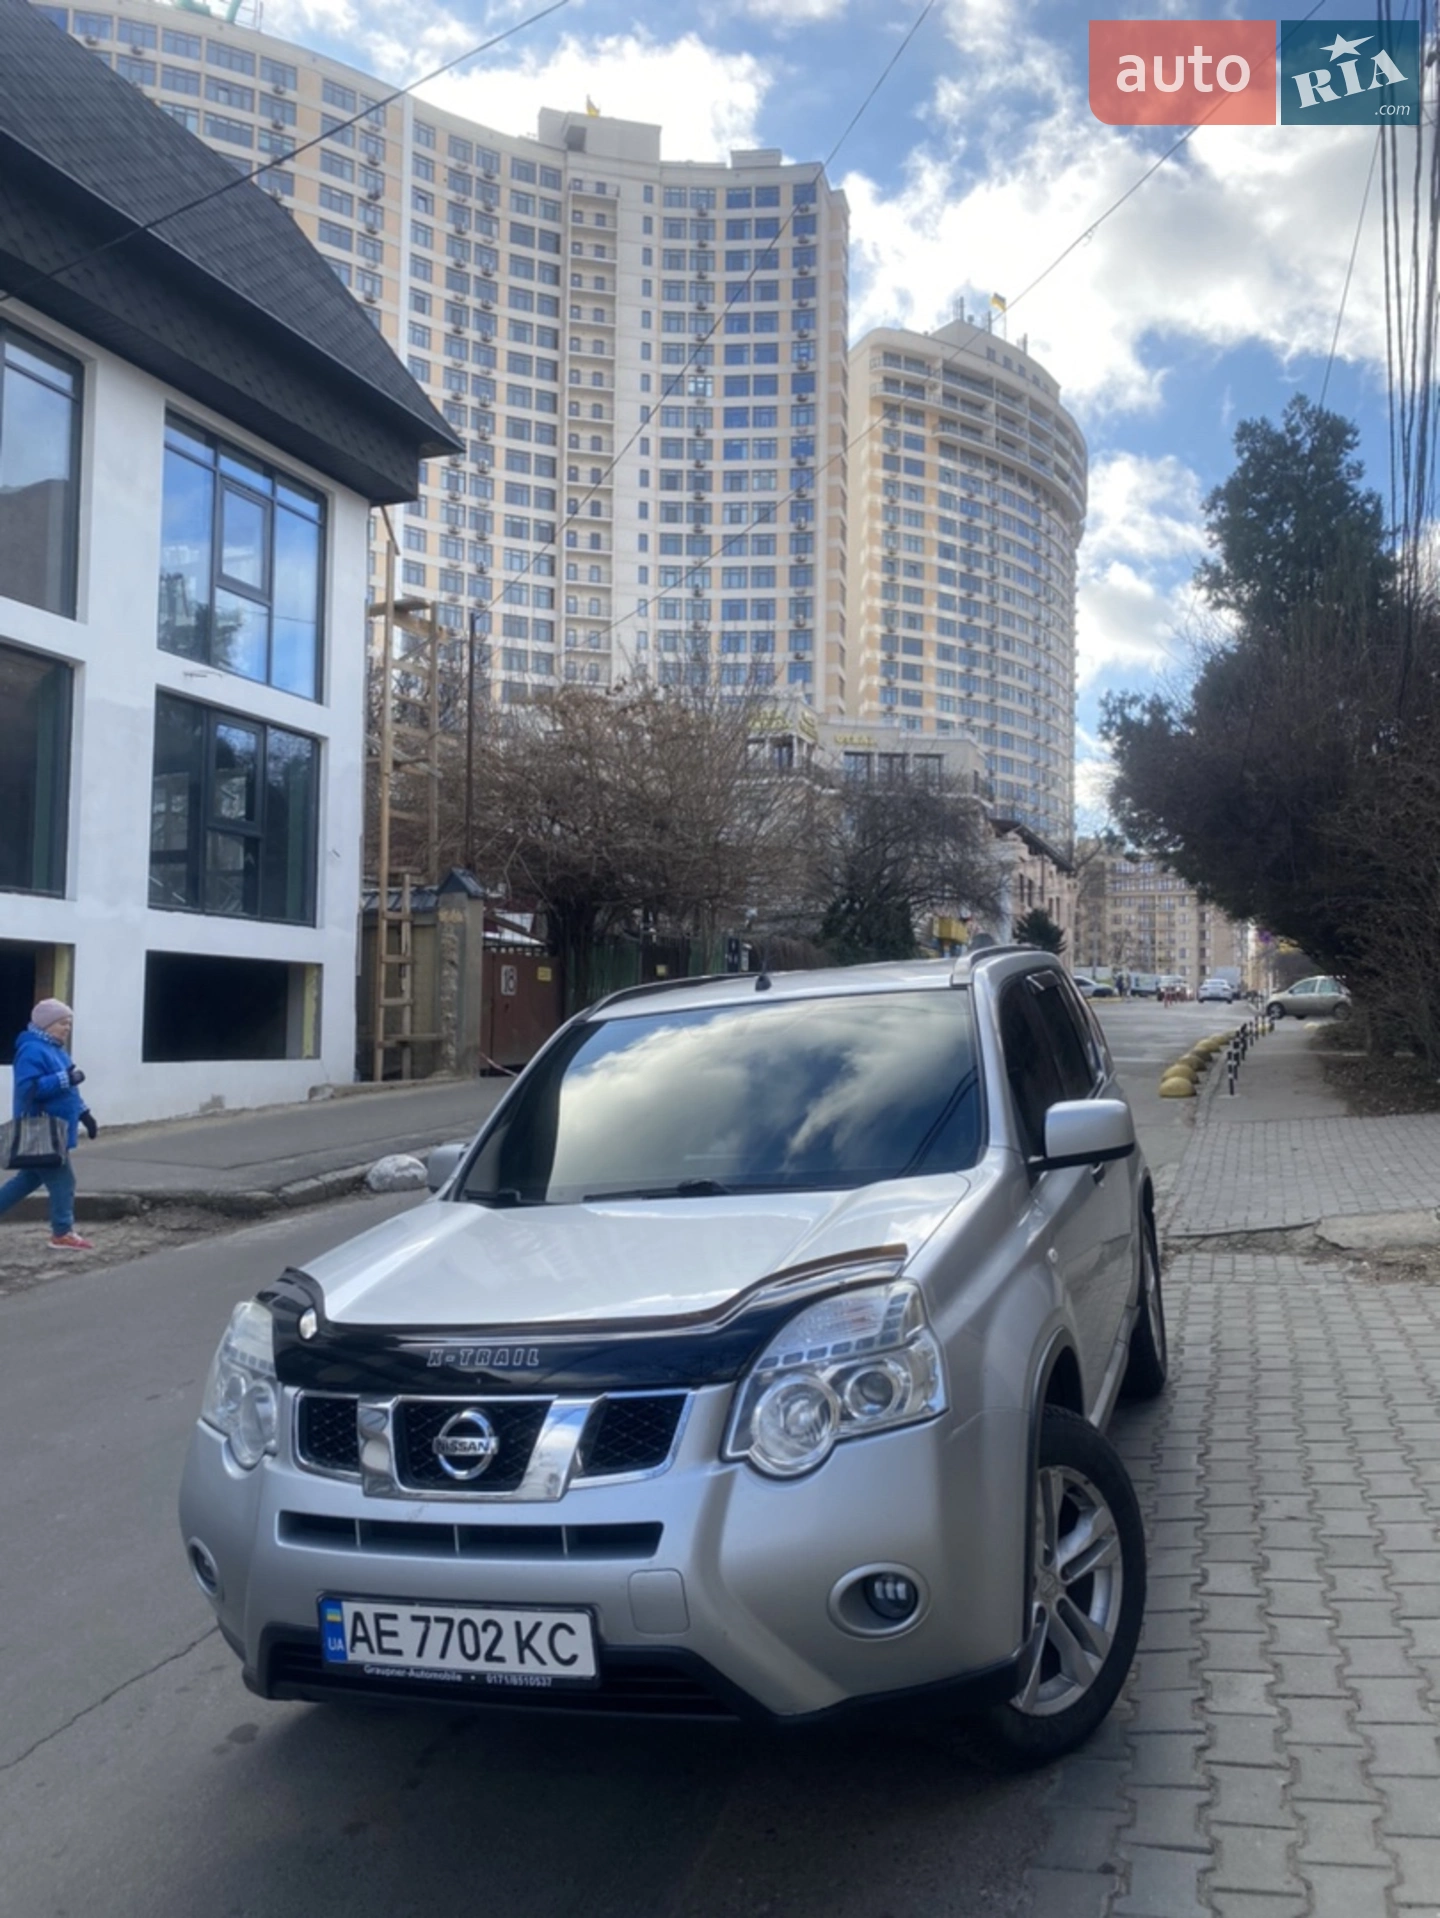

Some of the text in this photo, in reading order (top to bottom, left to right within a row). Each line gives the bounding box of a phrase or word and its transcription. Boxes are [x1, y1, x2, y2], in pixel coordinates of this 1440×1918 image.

[428, 1349, 540, 1367] X-TRAIL
[436, 1439, 491, 1452] NISSAN
[328, 1638, 344, 1651] UA
[350, 1611, 579, 1666] AE 7702 KC
